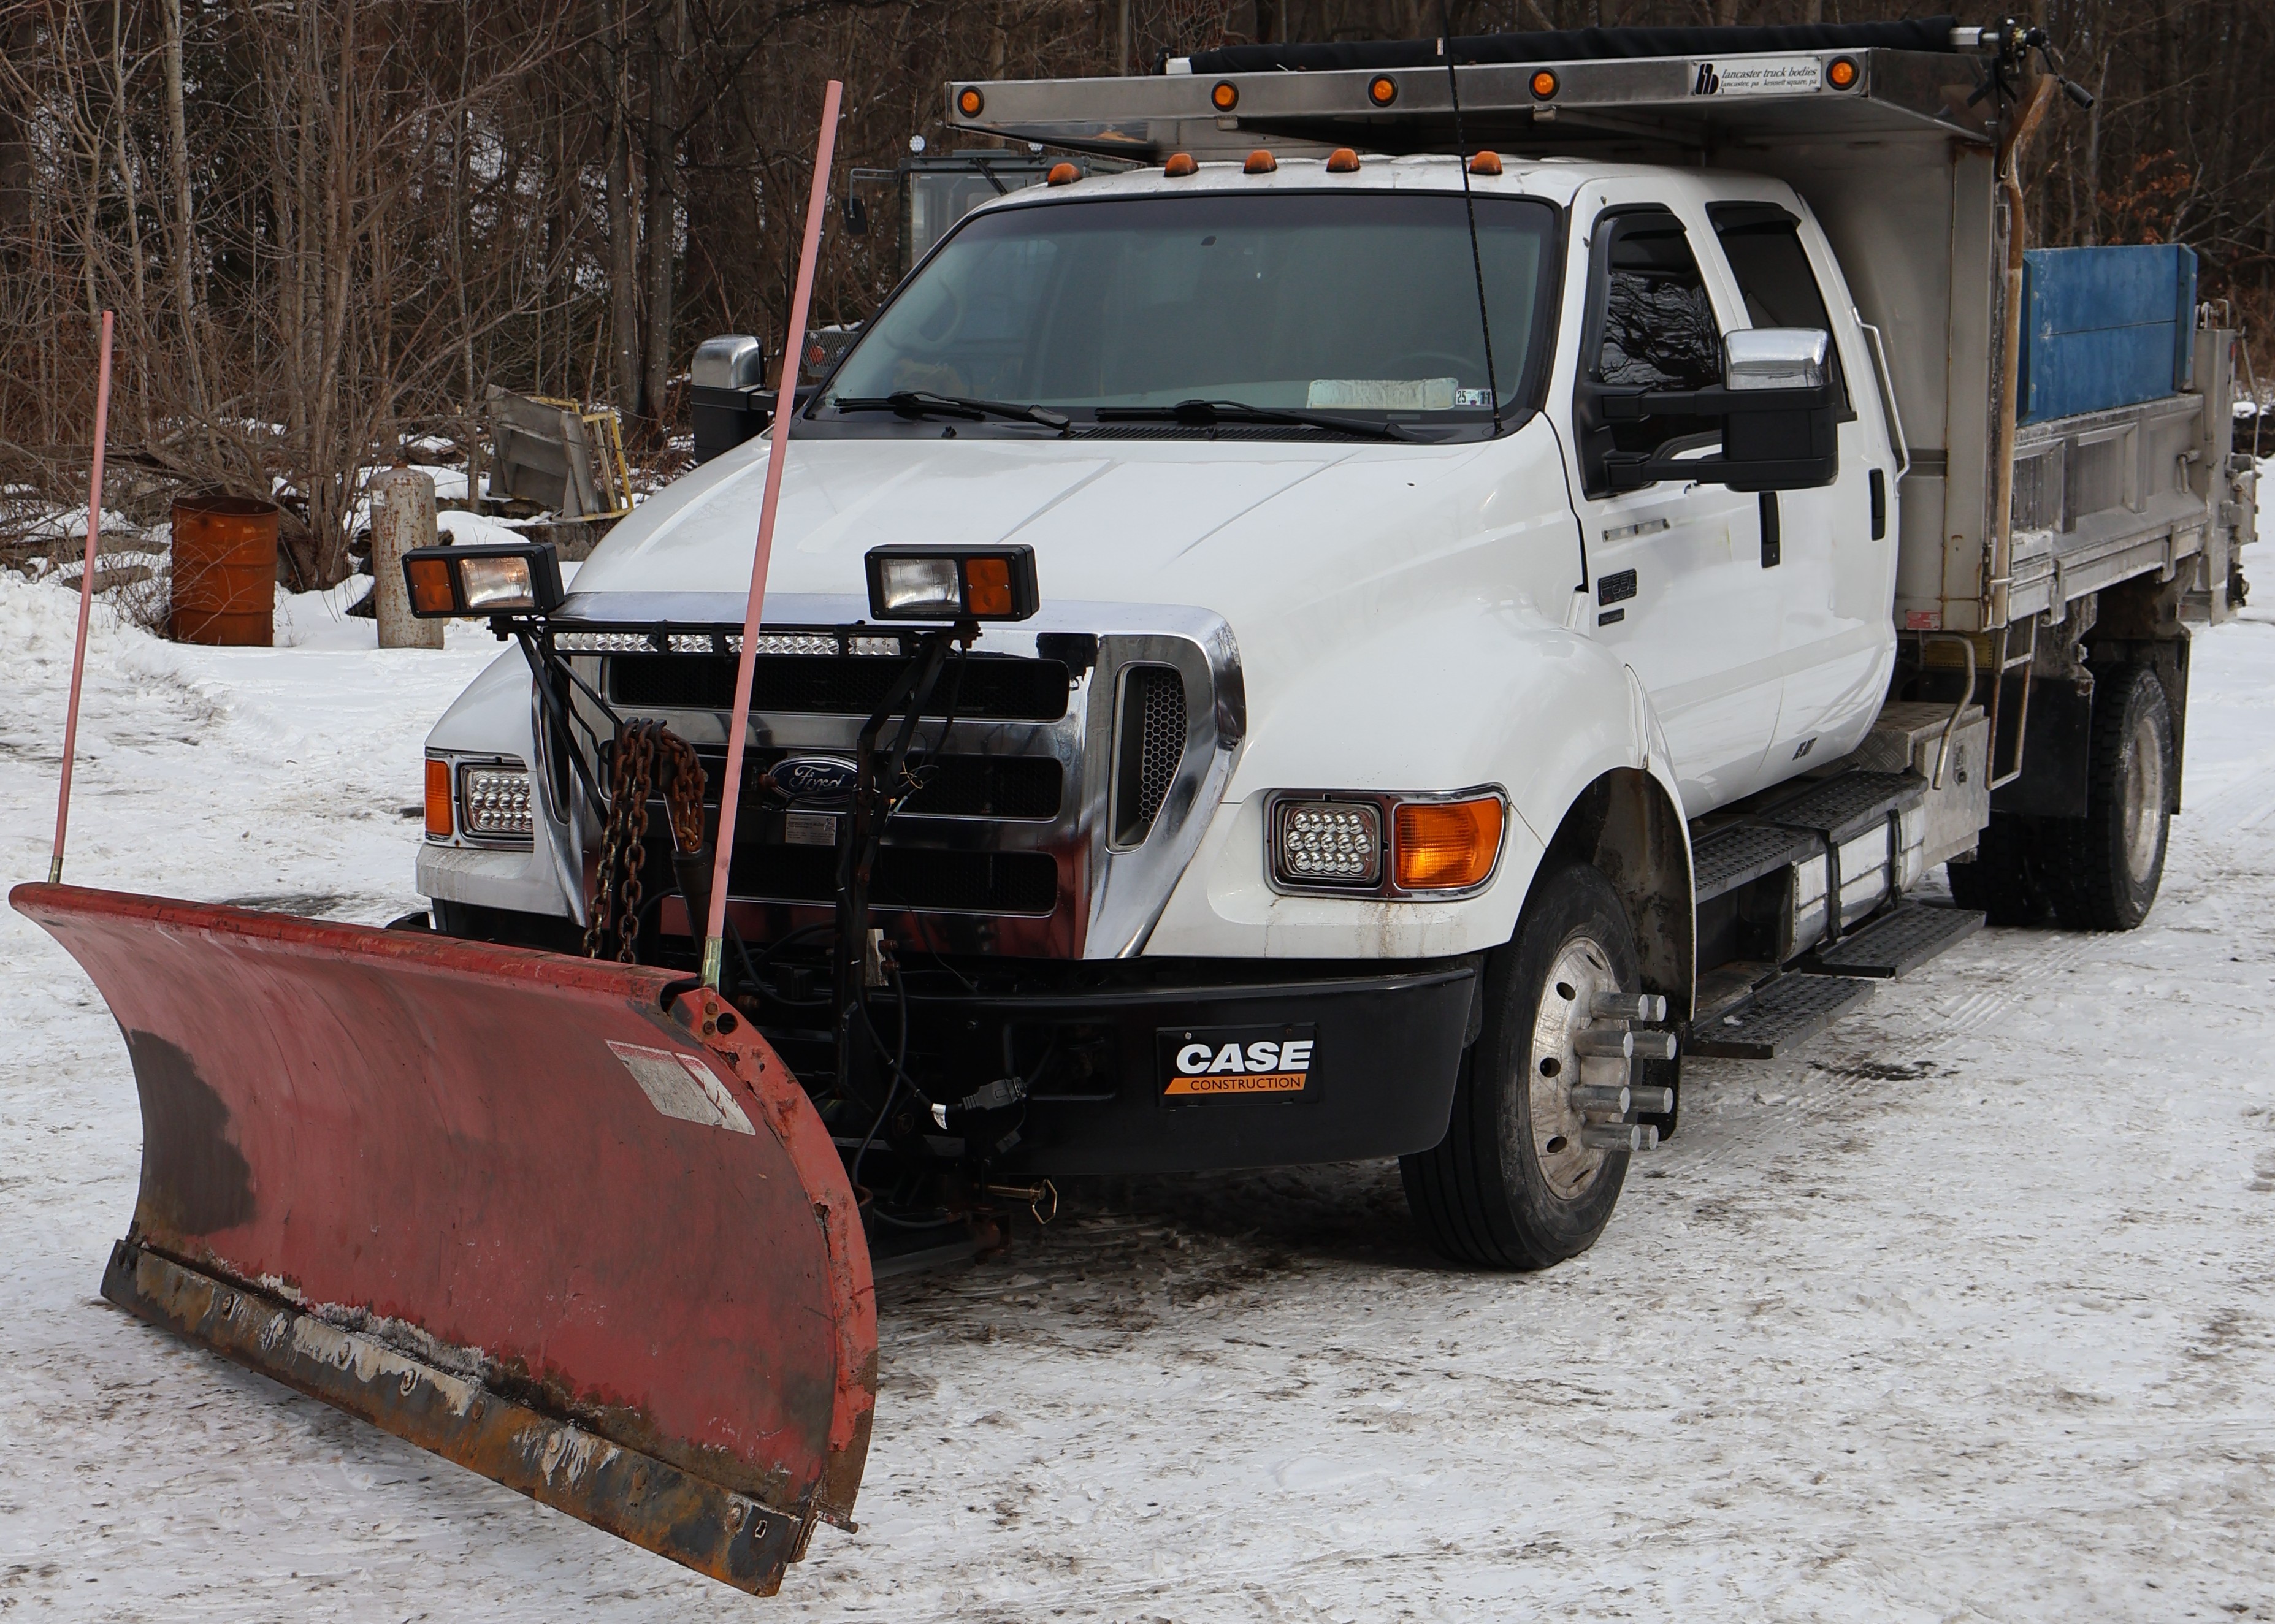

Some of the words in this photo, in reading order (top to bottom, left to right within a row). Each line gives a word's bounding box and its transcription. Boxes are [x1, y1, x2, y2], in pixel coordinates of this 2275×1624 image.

[1721, 69, 1762, 79] lancaster
[1763, 67, 1787, 78] truck
[1788, 66, 1817, 77] bodies
[1457, 390, 1467, 403] 25
[1480, 391, 1491, 405] 11
[789, 765, 846, 791] Ford
[1176, 1040, 1314, 1074] CASE
[1190, 1077, 1301, 1091] CONSTRUCTION
